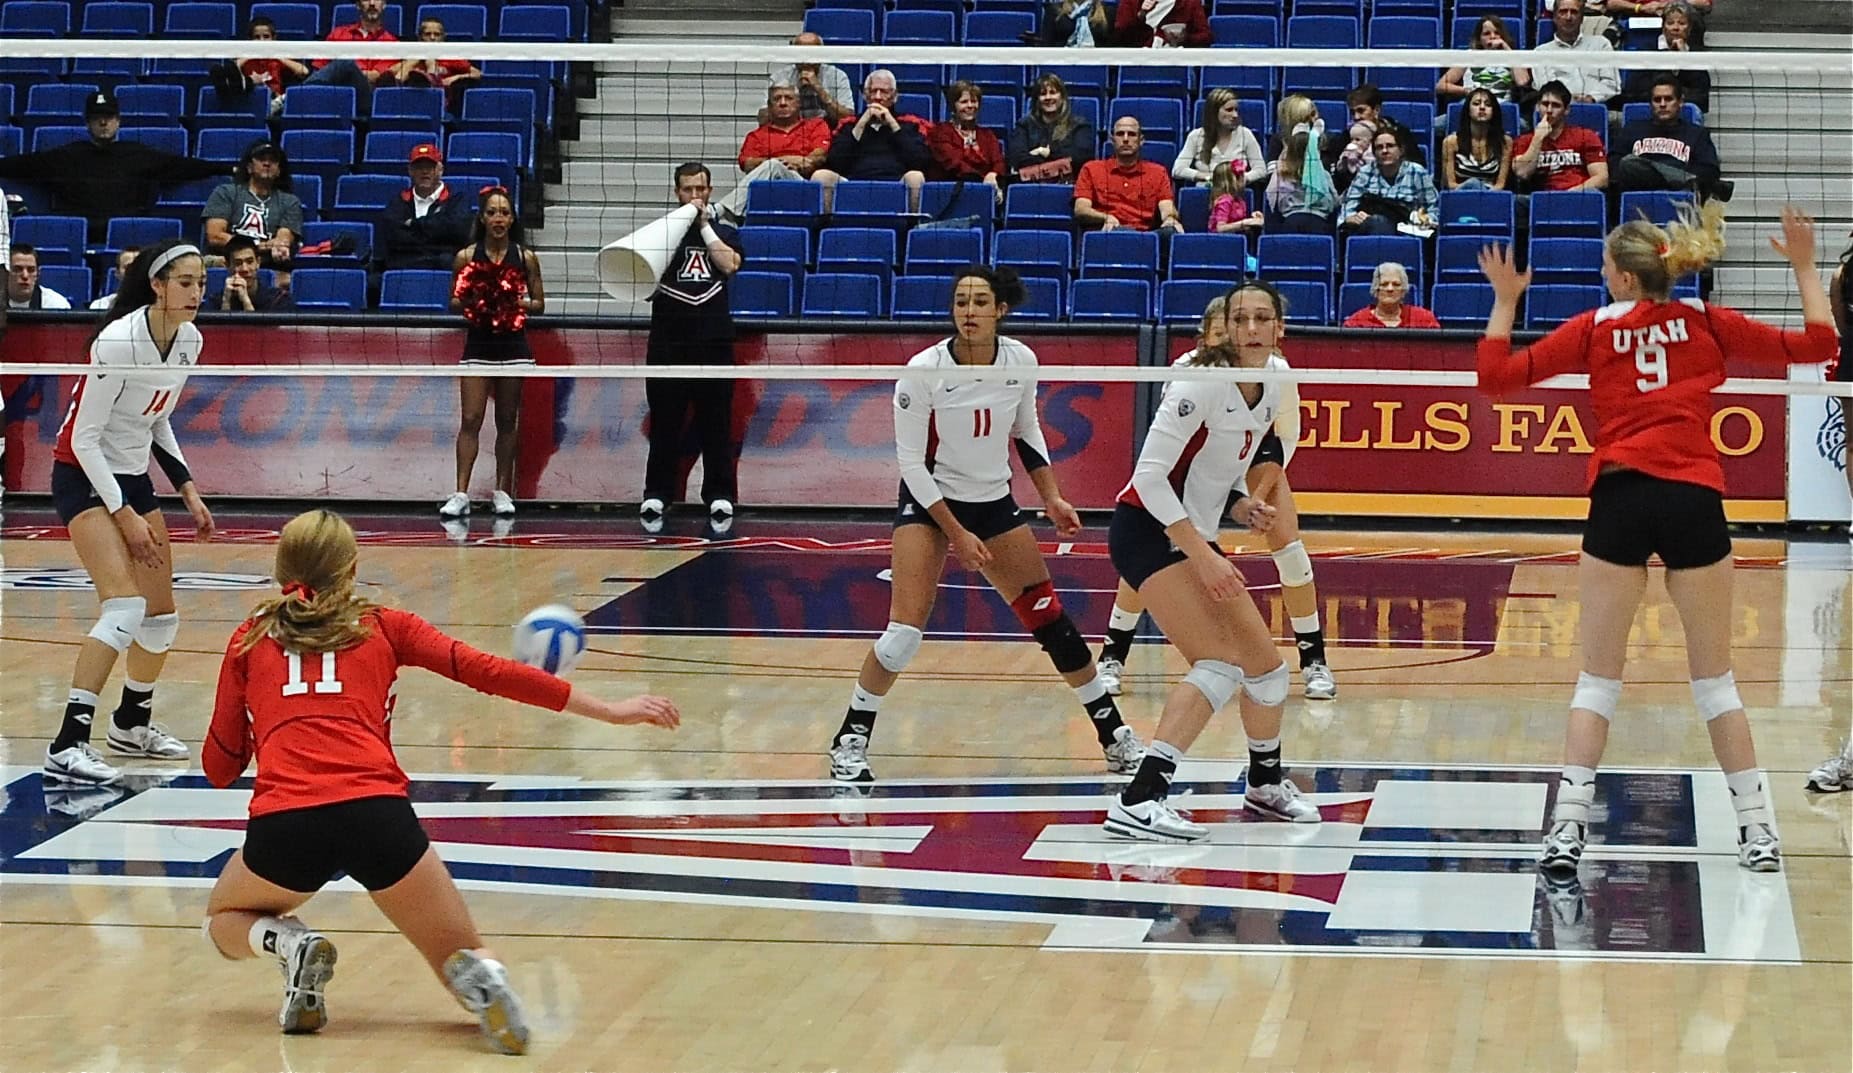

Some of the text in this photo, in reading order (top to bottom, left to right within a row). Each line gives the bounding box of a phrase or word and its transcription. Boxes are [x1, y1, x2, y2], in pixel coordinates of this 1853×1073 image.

[1536, 152, 1583, 168] RIZONA
[1632, 137, 1691, 162] ARIZONA
[232, 203, 272, 245] A
[677, 247, 711, 282] A
[1613, 317, 1689, 354] UTAH
[1635, 344, 1669, 394] 9
[8, 373, 458, 448] AZONA
[142, 389, 171, 416] 14
[973, 408, 991, 438] 11
[1297, 400, 1764, 456] LLS FAO
[1238, 429, 1253, 461] 8
[282, 648, 343, 697] 11
